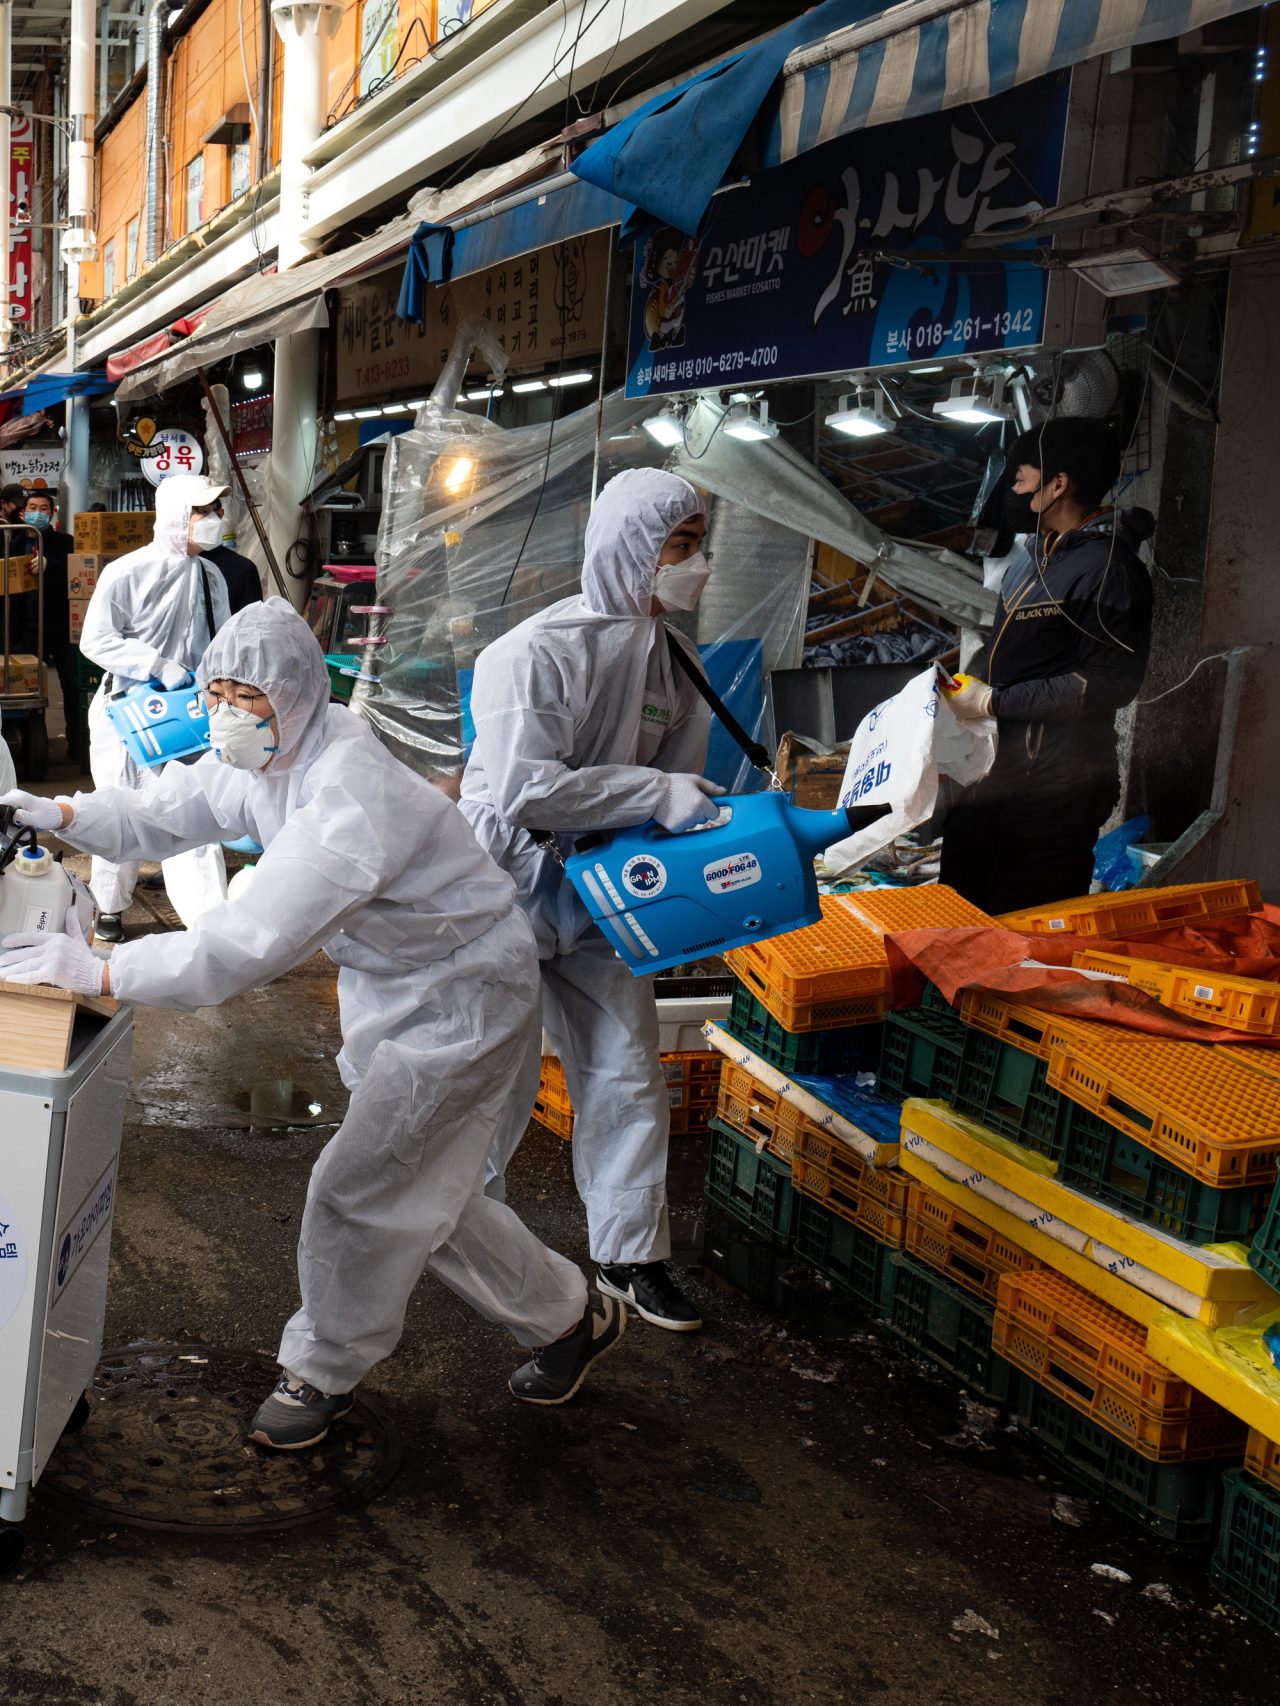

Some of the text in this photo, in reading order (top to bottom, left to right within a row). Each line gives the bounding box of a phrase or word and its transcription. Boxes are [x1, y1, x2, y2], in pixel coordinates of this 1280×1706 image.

[703, 226, 791, 288] 수산마켓
[706, 277, 781, 304] FISHES MARKET EOSATTO
[843, 259, 877, 316] 魚
[886, 308, 1033, 353] 본사 018-261-1342
[636, 346, 778, 386] 송파 새마을 시장 010-6279-4700
[161, 433, 187, 443] 남서울
[1015, 609, 1042, 621] BLACK
[630, 870, 655, 883] GAON
[706, 868, 729, 881] GOOD
[730, 863, 745, 875] FOG
[746, 859, 757, 869] 48
